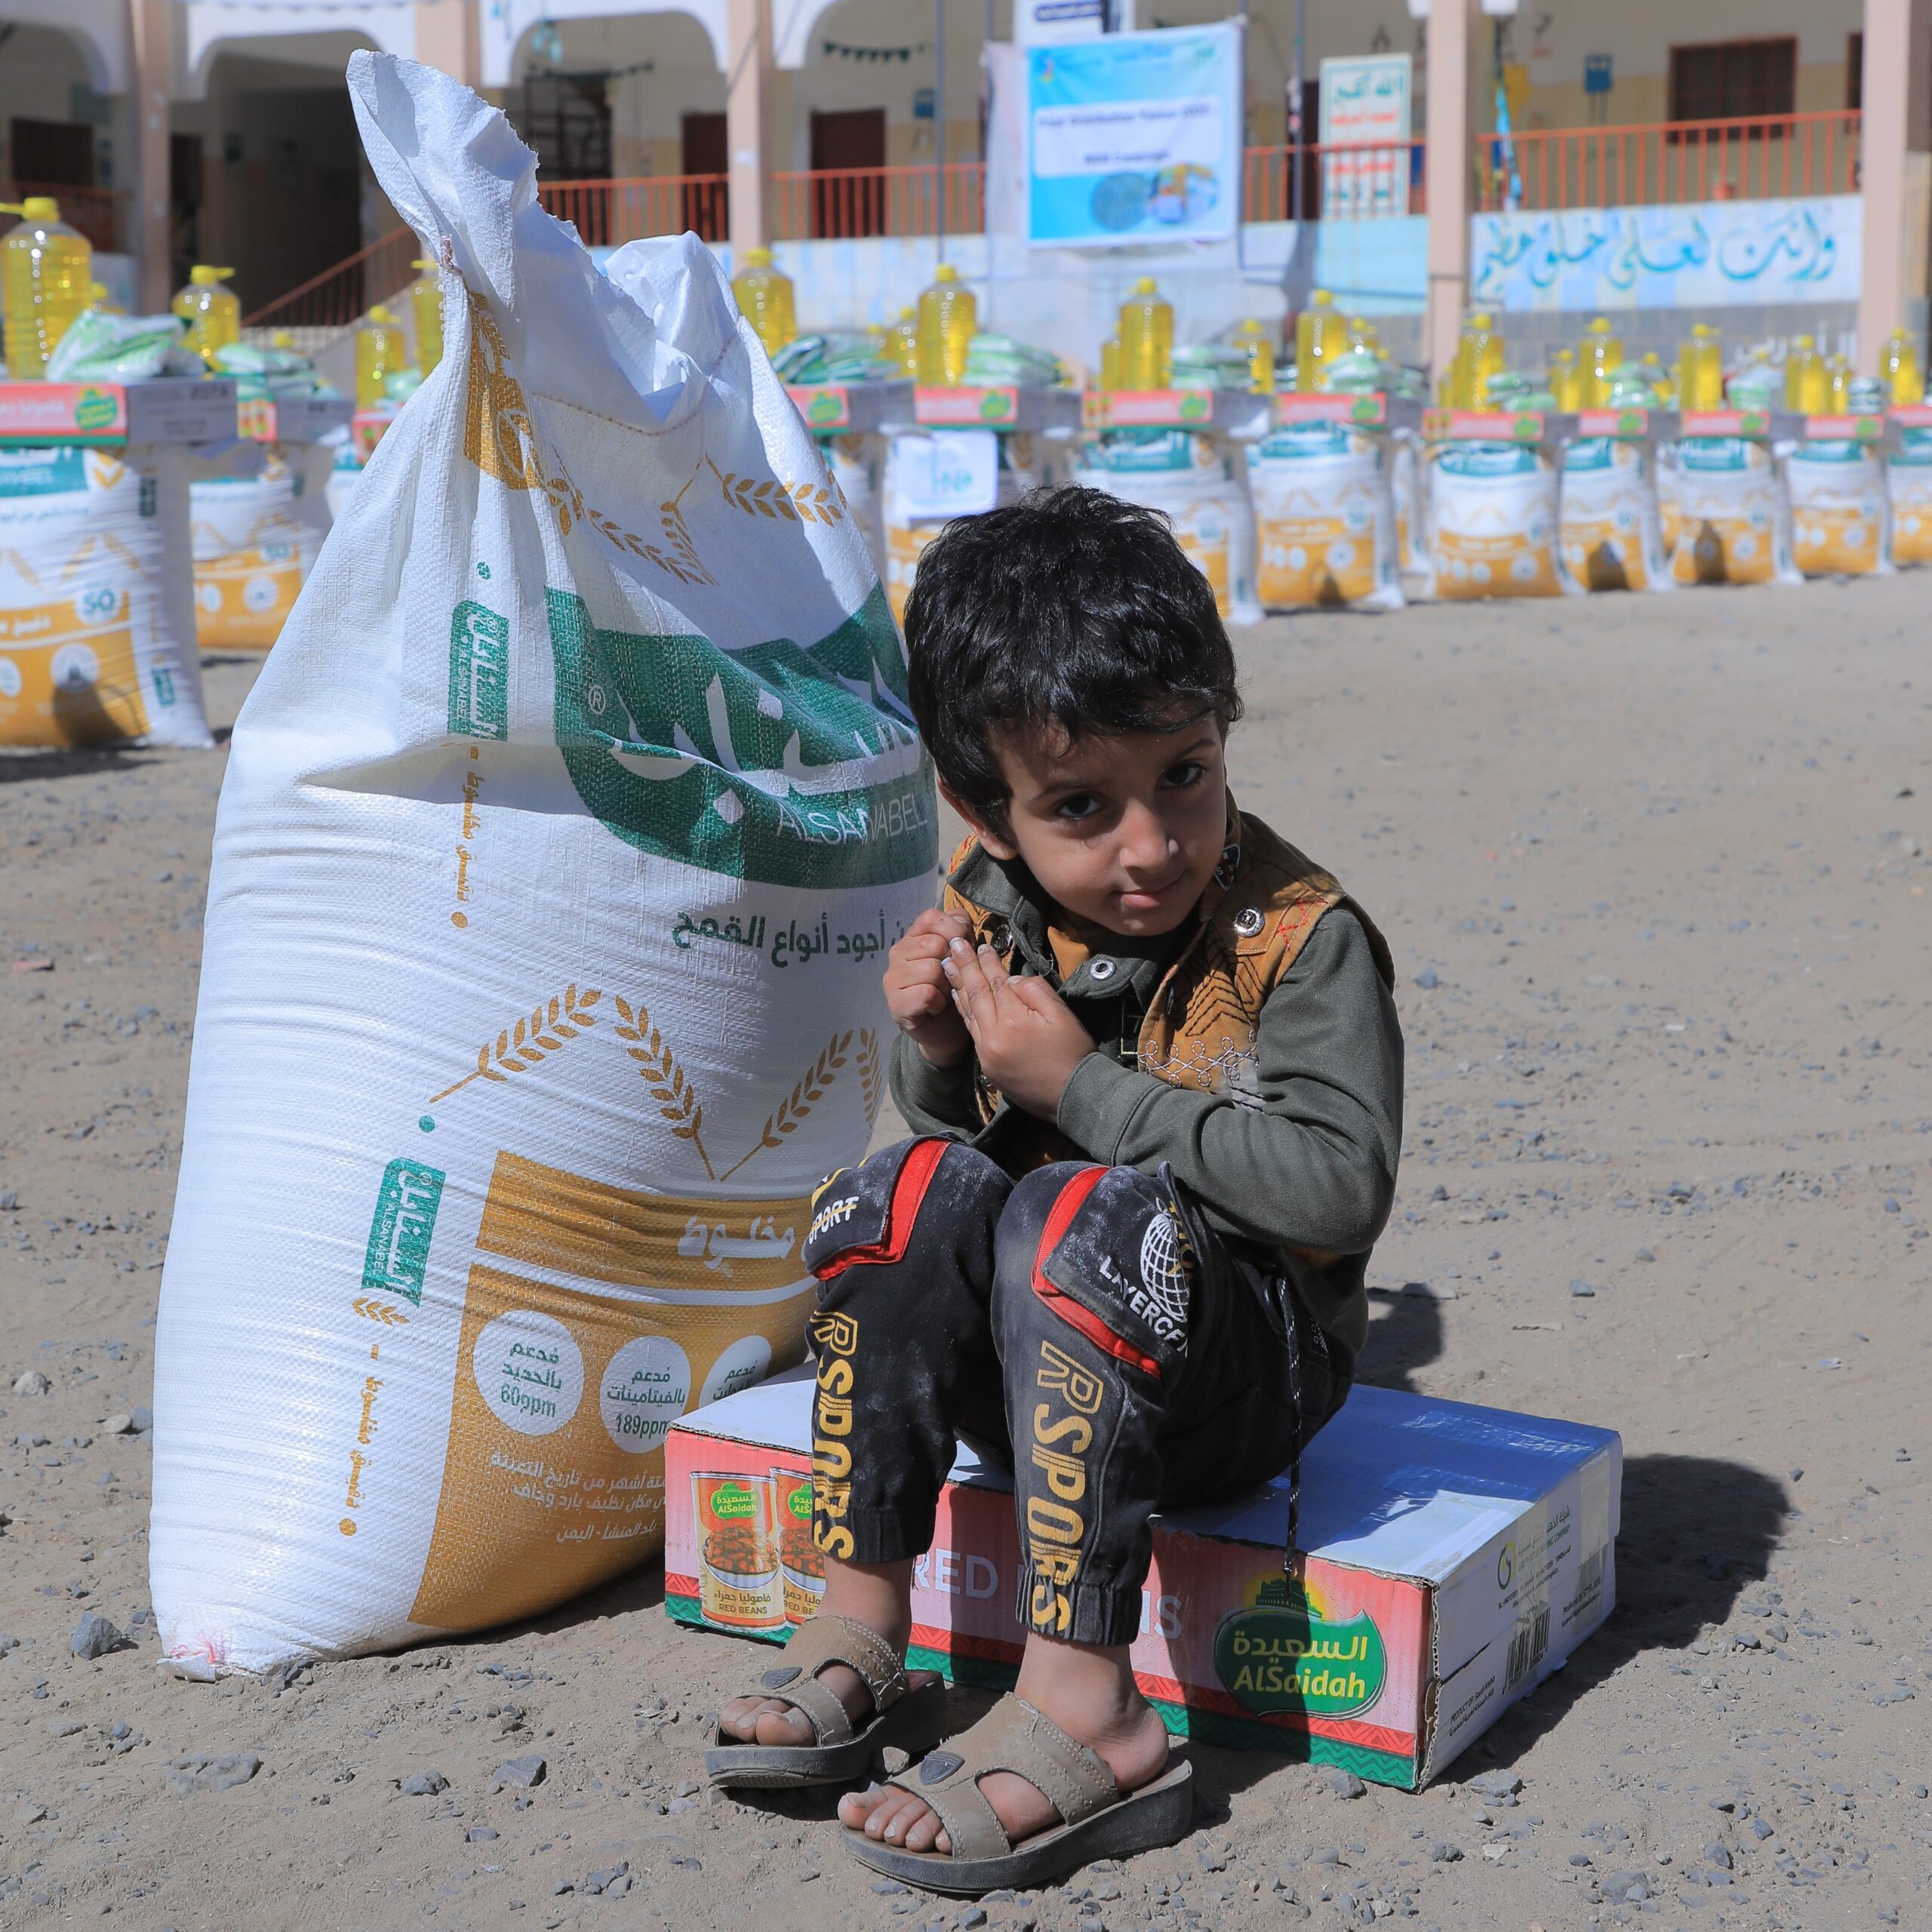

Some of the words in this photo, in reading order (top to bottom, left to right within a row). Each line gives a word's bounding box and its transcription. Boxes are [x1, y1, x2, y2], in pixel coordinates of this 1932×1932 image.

[83, 587, 115, 616] 50
[672, 911, 766, 950] القمح
[771, 912, 829, 968] أنواع
[837, 909, 885, 963] أجود
[372, 1201, 395, 1275] ALSANABEL
[677, 1214, 796, 1270] مخلوط
[502, 1363, 563, 1392] بالحديد
[607, 1386, 686, 1407] بالفيتامينات
[614, 1413, 671, 1440] 189ppm
[583, 1474, 605, 1492] من
[606, 1469, 648, 1493] أشهر
[586, 1494, 626, 1513] نظيف
[716, 1493, 756, 1506] السعيدة
[717, 1504, 757, 1514] AlSaidah
[556, 1524, 595, 1543] اليمن
[602, 1520, 643, 1540] المنشأ
[639, 1519, 657, 1535] بلد
[714, 1589, 737, 1603] حمراء
[738, 1593, 772, 1606] فاصوليا
[718, 1602, 737, 1613] RED
[738, 1604, 768, 1614] BEANS
[1232, 1629, 1368, 1664] السعيدة
[1232, 1664, 1366, 1700] AlSaidah
